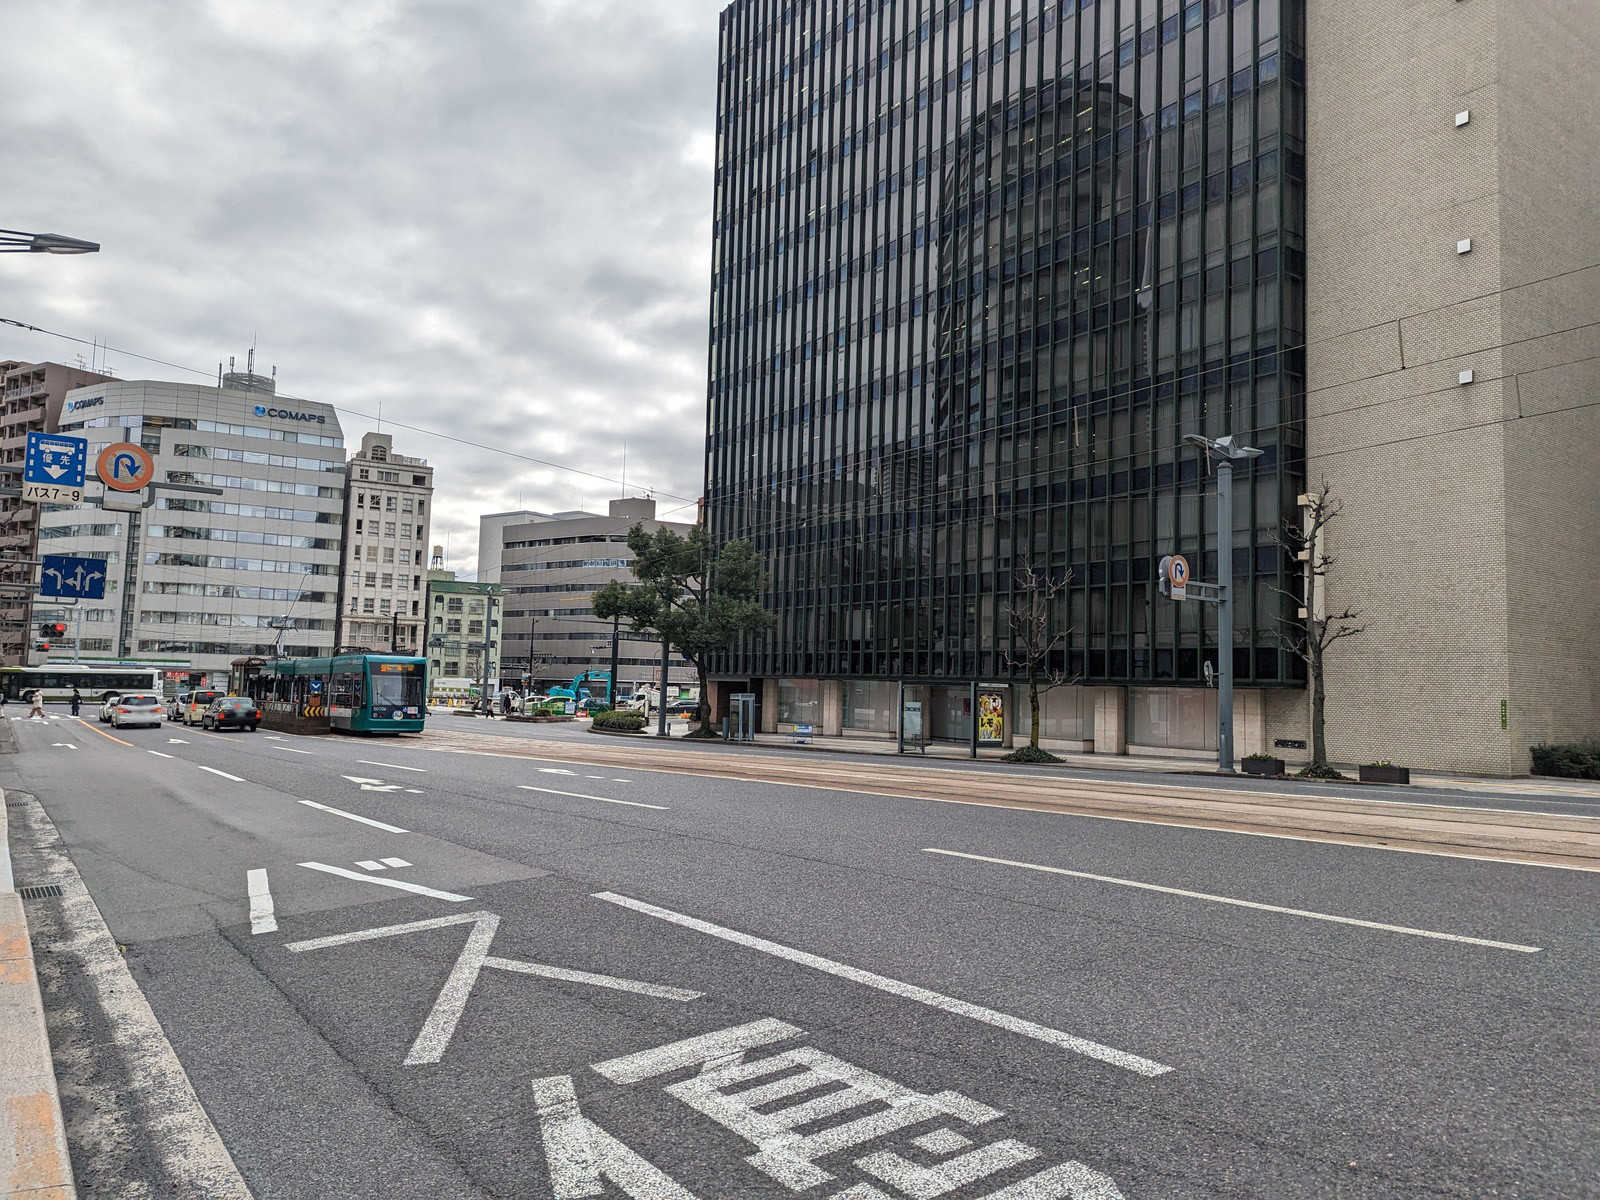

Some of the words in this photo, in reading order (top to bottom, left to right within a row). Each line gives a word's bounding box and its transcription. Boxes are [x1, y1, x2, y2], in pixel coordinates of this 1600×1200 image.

[74, 397, 104, 410] COMAPS
[267, 408, 326, 424] COMAPS
[43, 453, 71, 465] 優先
